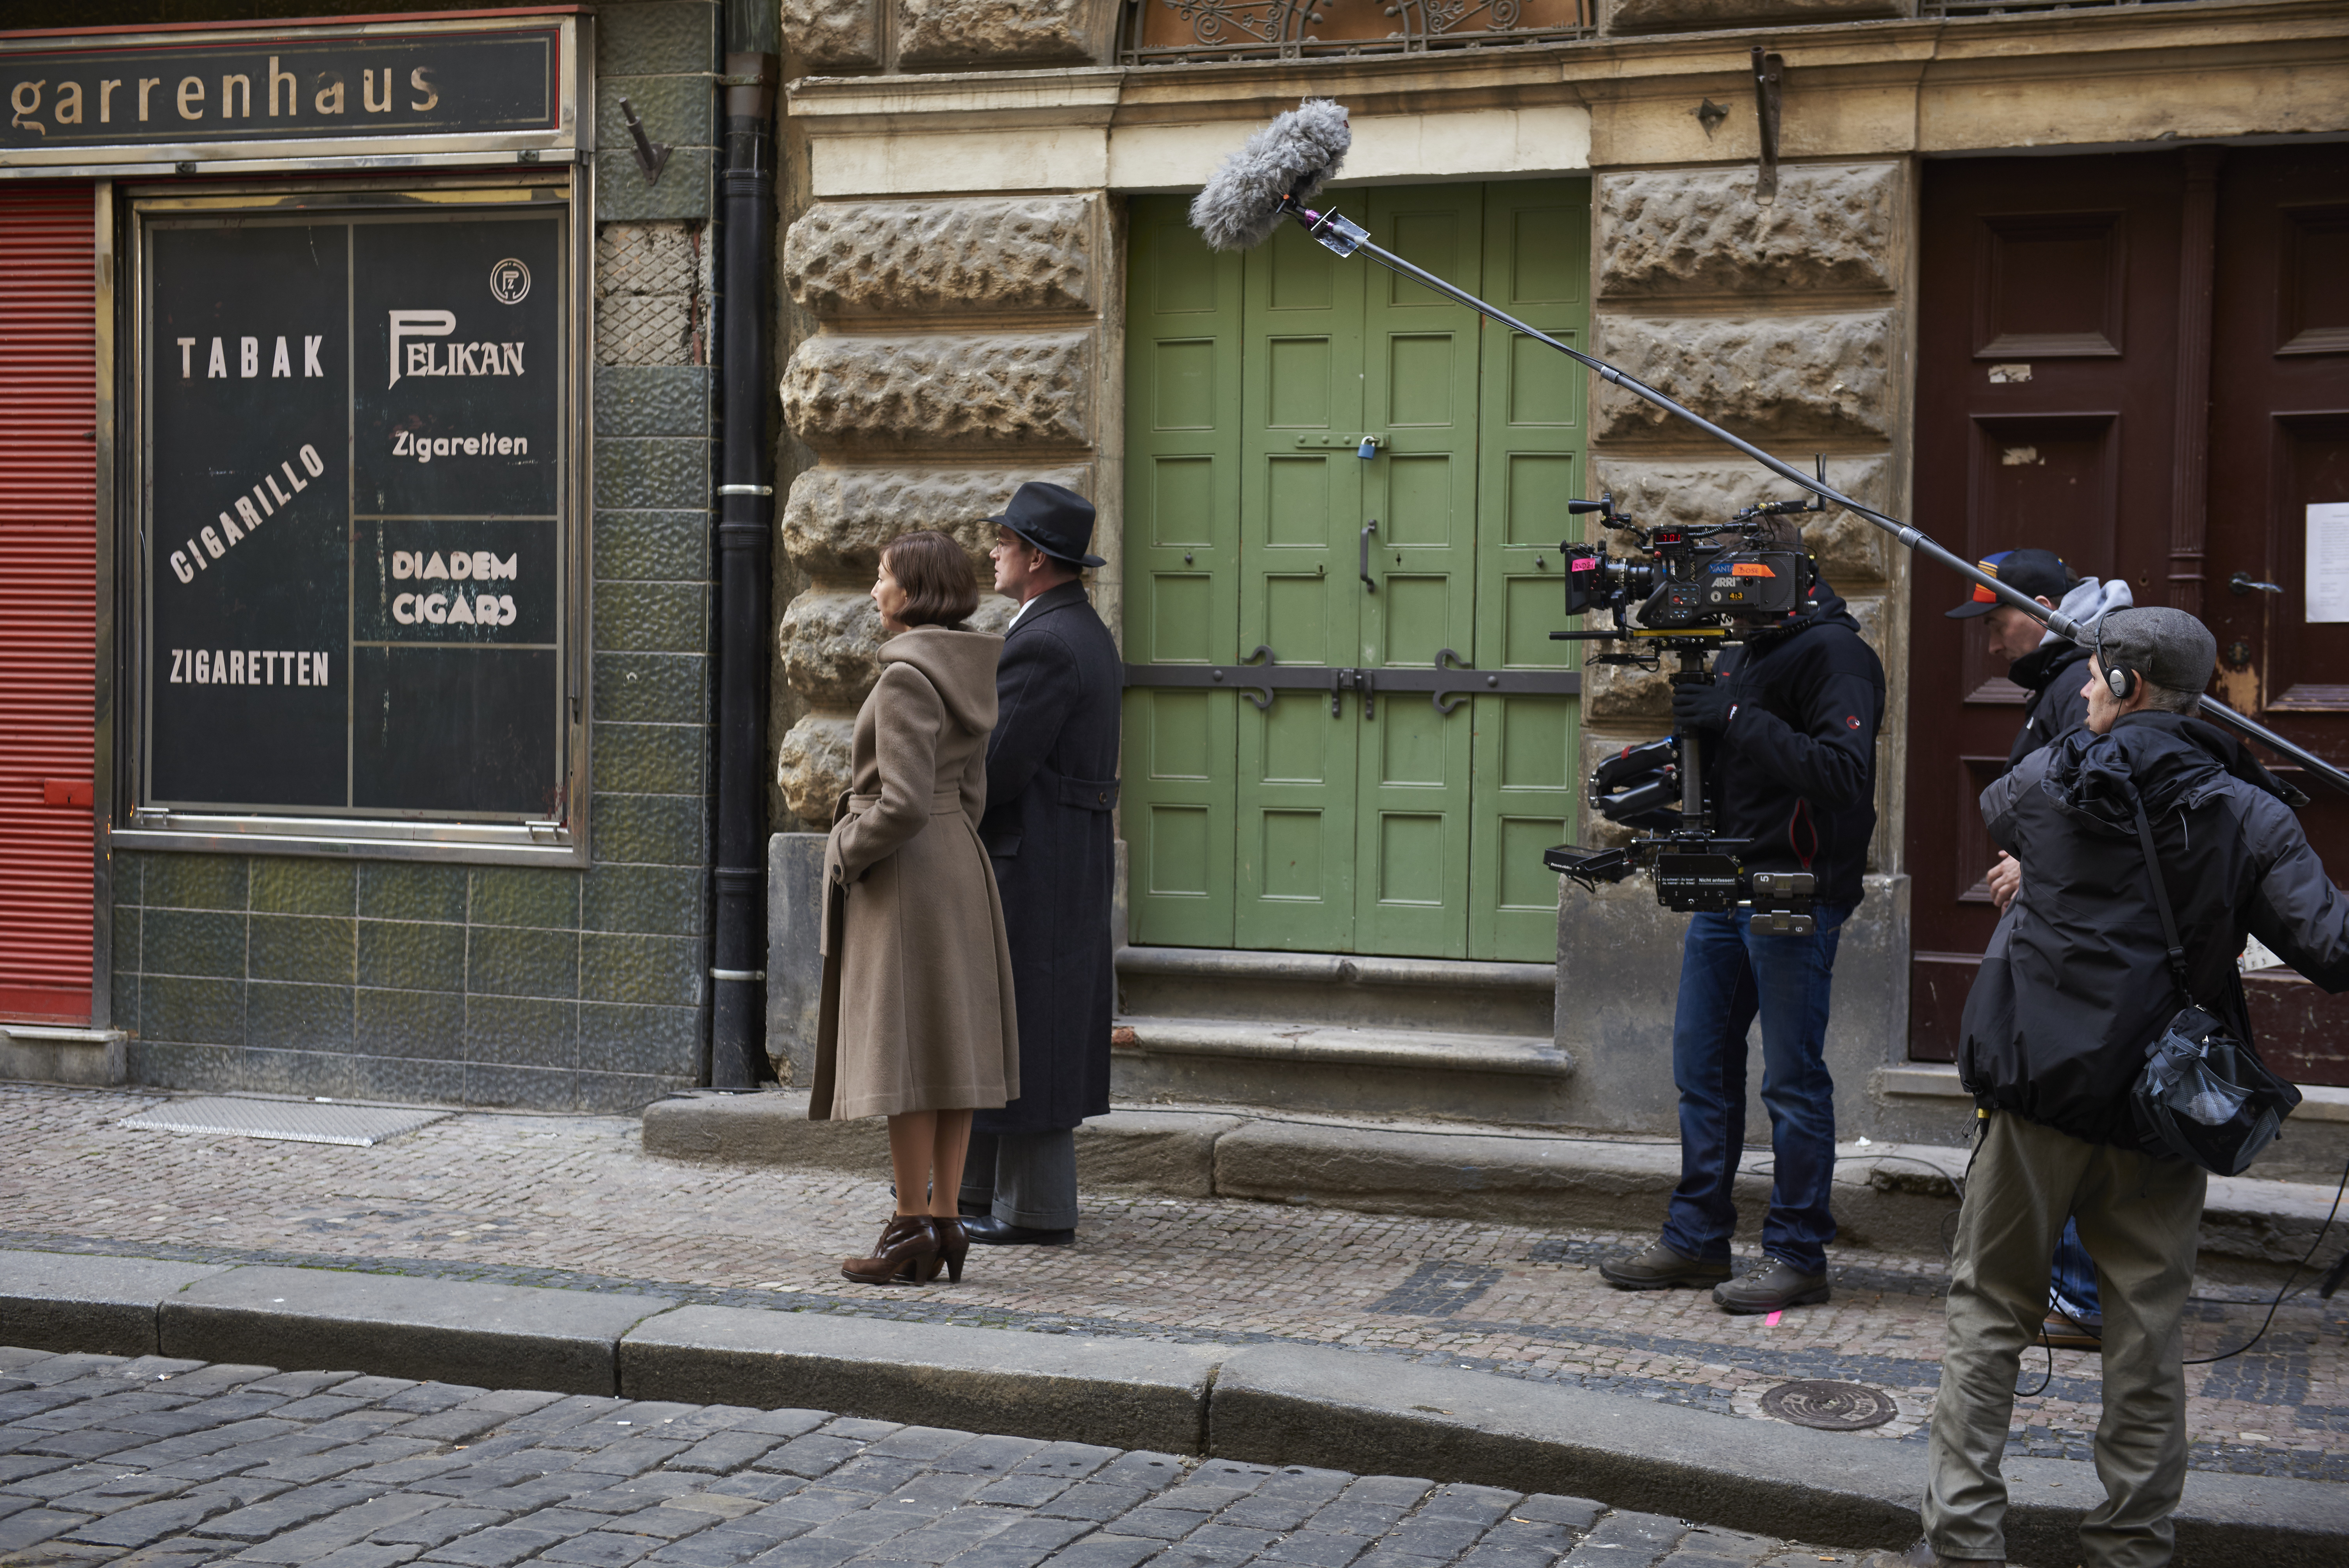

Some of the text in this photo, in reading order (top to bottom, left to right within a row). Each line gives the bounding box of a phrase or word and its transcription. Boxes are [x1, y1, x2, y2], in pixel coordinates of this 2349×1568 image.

[11, 56, 439, 136] garrenhaus
[177, 335, 324, 378] TABAK
[388, 309, 525, 390] PELIKAN
[392, 430, 528, 463] Zigaretten
[170, 443, 324, 584] CIGARILLO
[392, 550, 517, 581] DIADEM
[1711, 577, 1736, 587] ARRI
[392, 592, 517, 627] CIGARS
[170, 649, 328, 686] ZIGARETTEN
